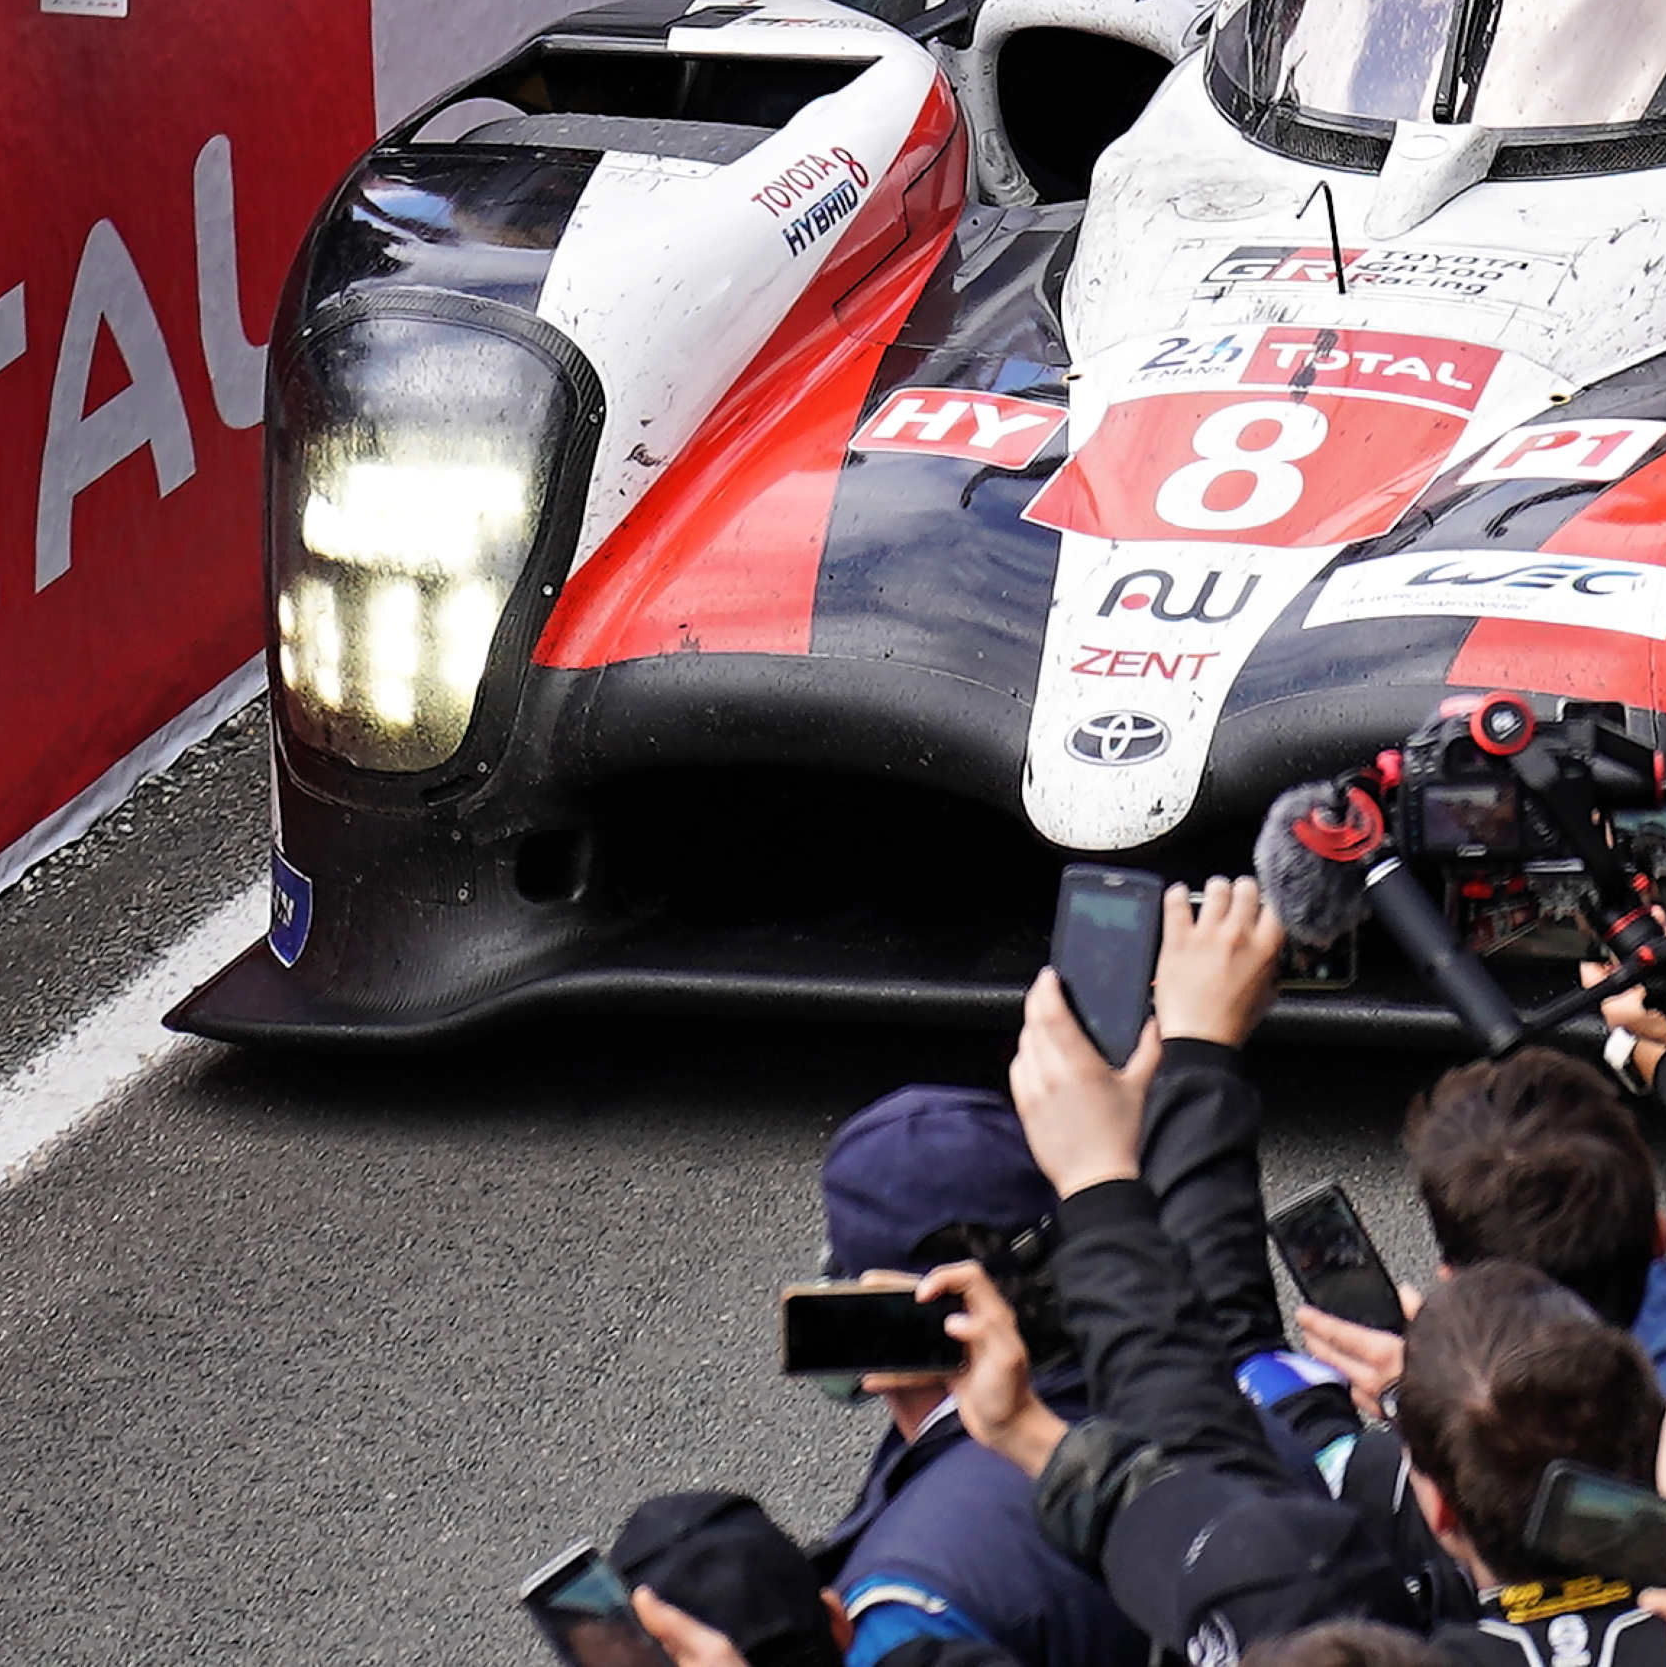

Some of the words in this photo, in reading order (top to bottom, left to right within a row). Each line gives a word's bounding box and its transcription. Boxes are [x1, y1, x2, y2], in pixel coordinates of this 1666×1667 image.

[750, 153, 839, 218] TOYOTA
[831, 146, 870, 189] 8
[781, 179, 860, 258] HYBRID
[1353, 261, 1505, 282] GAZOO
[1380, 248, 1531, 272] TOYOTA
[1346, 271, 1489, 296] Racing
[1268, 341, 1474, 391] TOTAL
[876, 393, 1051, 450] HY
[1154, 400, 1331, 532] 8
[1496, 429, 1621, 469] P1
[1070, 644, 1222, 681] ZENT
